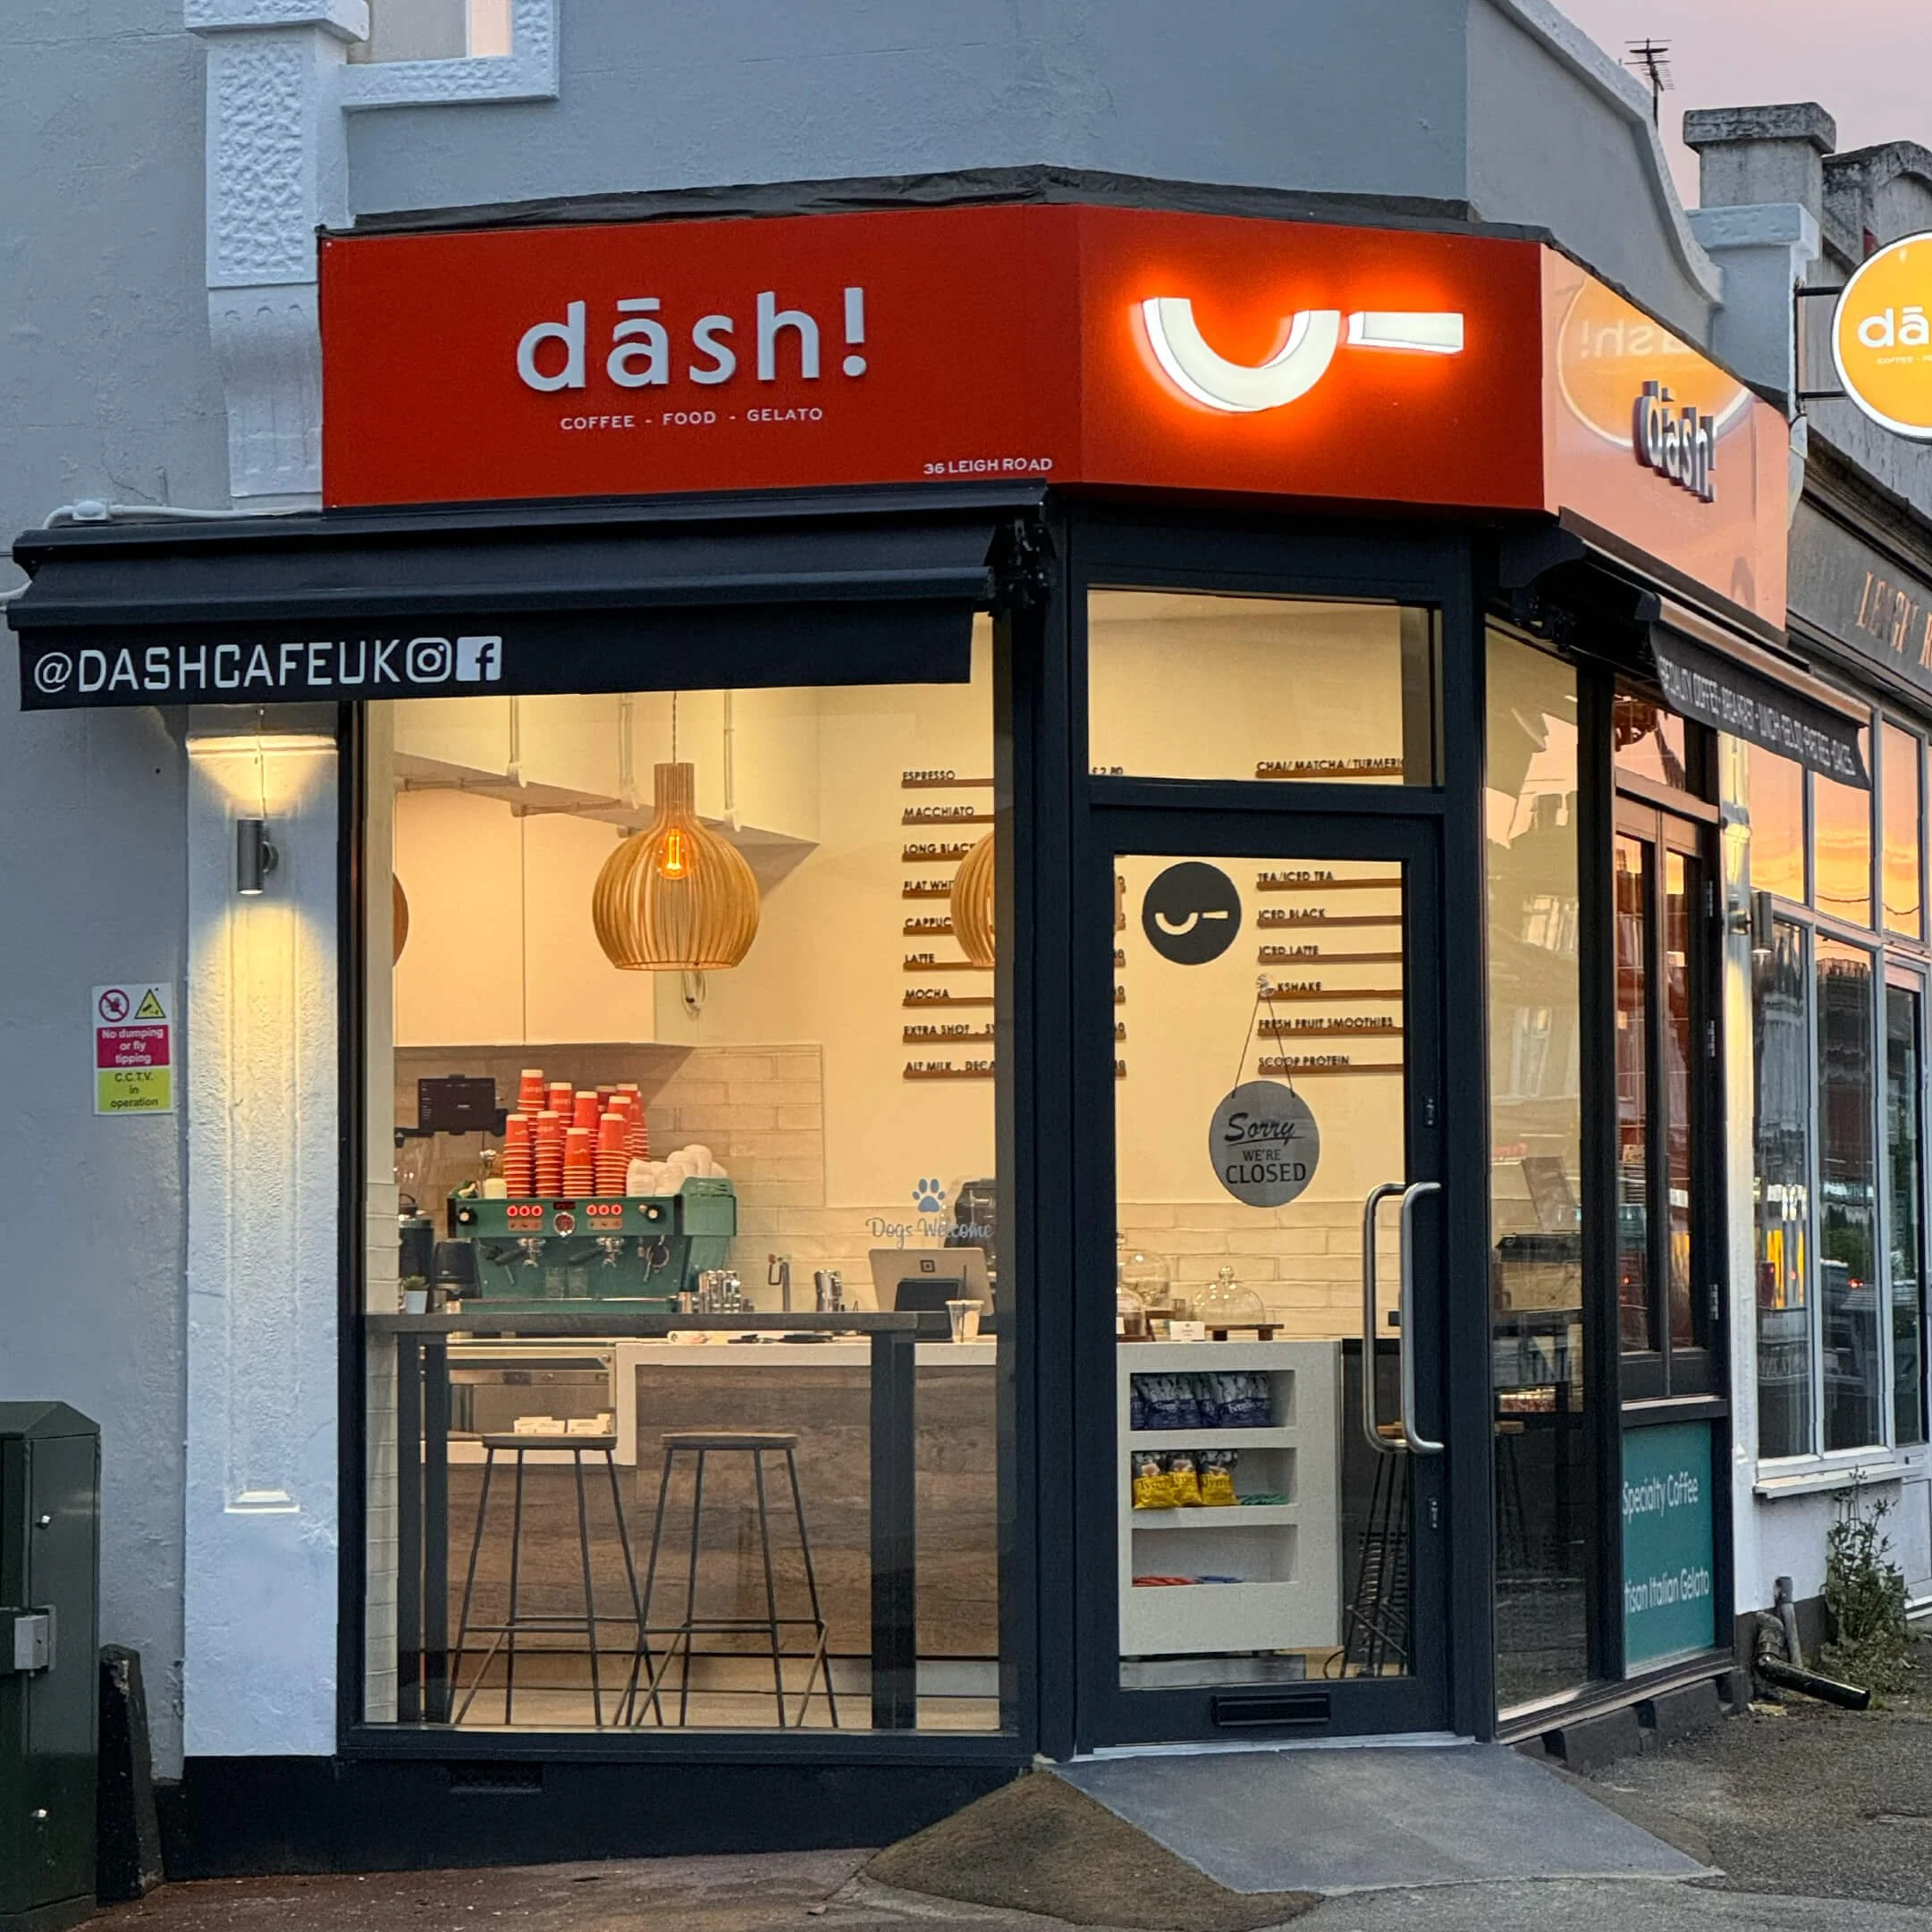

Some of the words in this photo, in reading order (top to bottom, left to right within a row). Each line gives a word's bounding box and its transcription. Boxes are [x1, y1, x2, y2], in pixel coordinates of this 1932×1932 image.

[517, 287, 867, 392] dāsh!
[561, 415, 635, 430] COFFEE
[662, 410, 716, 426] FOOD
[747, 408, 823, 422] GELATO
[924, 463, 946, 475] 36
[948, 460, 999, 474] LEIGH
[1002, 458, 1053, 472] ROAD
[34, 638, 401, 694] @DASHCAFEUK
[903, 771, 955, 780] ESPRESSO
[904, 806, 974, 816] MACCHIATO
[904, 844, 936, 854] LONG
[1314, 871, 1334, 881] TEA
[905, 881, 927, 890] FLAT
[930, 881, 955, 890] WHIT
[1259, 909, 1285, 919] ICED
[1289, 908, 1325, 919] BLACK
[905, 917, 951, 928] CAPPUC
[1260, 946, 1286, 956] ICED
[1289, 945, 1320, 955] LATTE
[906, 953, 934, 963] LATTE
[1278, 981, 1321, 991] KSHAKE
[906, 989, 949, 999] MOCHA
[1259, 1019, 1291, 1029] FRESH
[1295, 1018, 1324, 1028] FRUIT
[1328, 1017, 1393, 1027] SMOOTHIES
[102, 1029, 116, 1039] No
[119, 1028, 164, 1040] dumping
[904, 1025, 936, 1035] EXTRA
[941, 1025, 969, 1034] SHOT
[120, 1042, 131, 1050] or
[133, 1041, 147, 1051] fly
[115, 1053, 152, 1064] tipping
[1259, 1057, 1300, 1067] SCOOP
[1303, 1056, 1350, 1066] PROTEIN
[907, 1061, 923, 1071] ALT
[927, 1061, 951, 1071] MILK
[966, 1060, 995, 1071] DECA
[129, 1085, 139, 1094] in
[110, 1098, 159, 1109] operation
[1224, 1112, 1295, 1146] Sorry
[1243, 1149, 1281, 1161] WE'RE
[1226, 1163, 1306, 1184] CLOSED
[865, 1217, 914, 1249] Dogs
[916, 1217, 994, 1239] Welcome
[1623, 1475, 1666, 1524] Specialty
[1667, 1472, 1699, 1507] Coffee
[1624, 1580, 1648, 1613] tisan
[1649, 1572, 1679, 1608] Italian
[1681, 1566, 1709, 1600] Gelato
